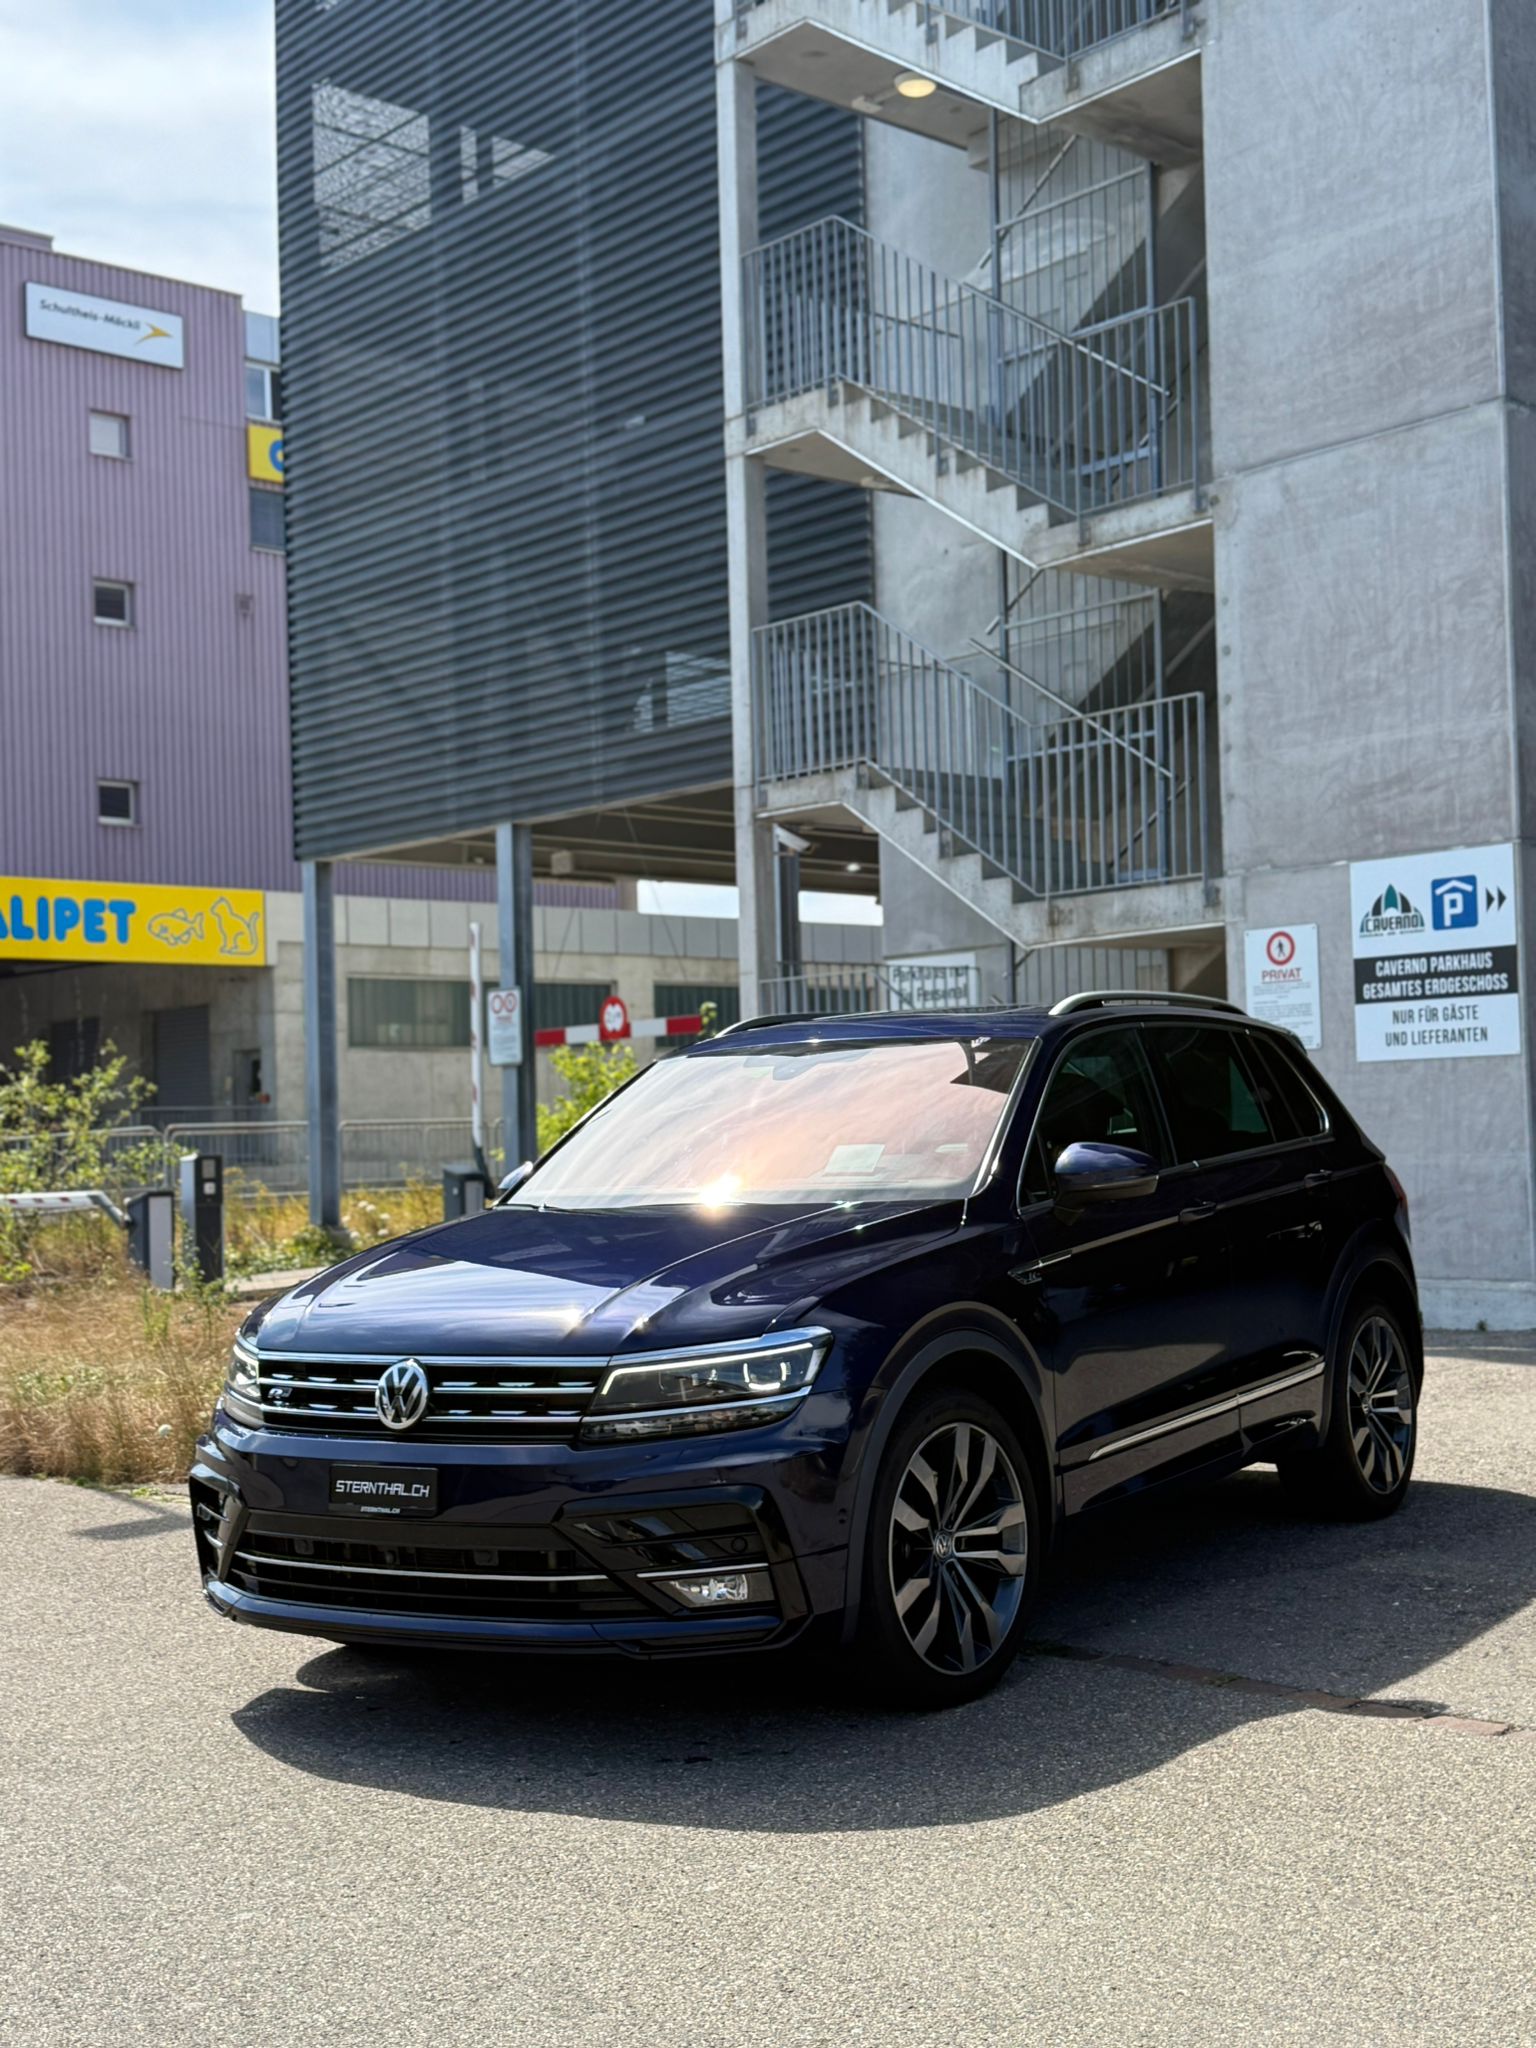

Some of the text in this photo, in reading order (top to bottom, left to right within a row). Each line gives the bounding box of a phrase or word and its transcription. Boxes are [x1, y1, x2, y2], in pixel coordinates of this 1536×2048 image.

[1365, 914, 1419, 932] CAVERNO
[1261, 967, 1302, 981] PRIVAT
[1375, 952, 1493, 977] CAVERNO PARKHAUS
[1363, 973, 1509, 1000] GESAMTES ERDGESCHOSS
[1392, 1004, 1479, 1025] NUR FÜR GÄSTE
[1385, 1026, 1488, 1047] UND LIEFERANTEN
[335, 1480, 430, 1498] STERNTHAL.CH
